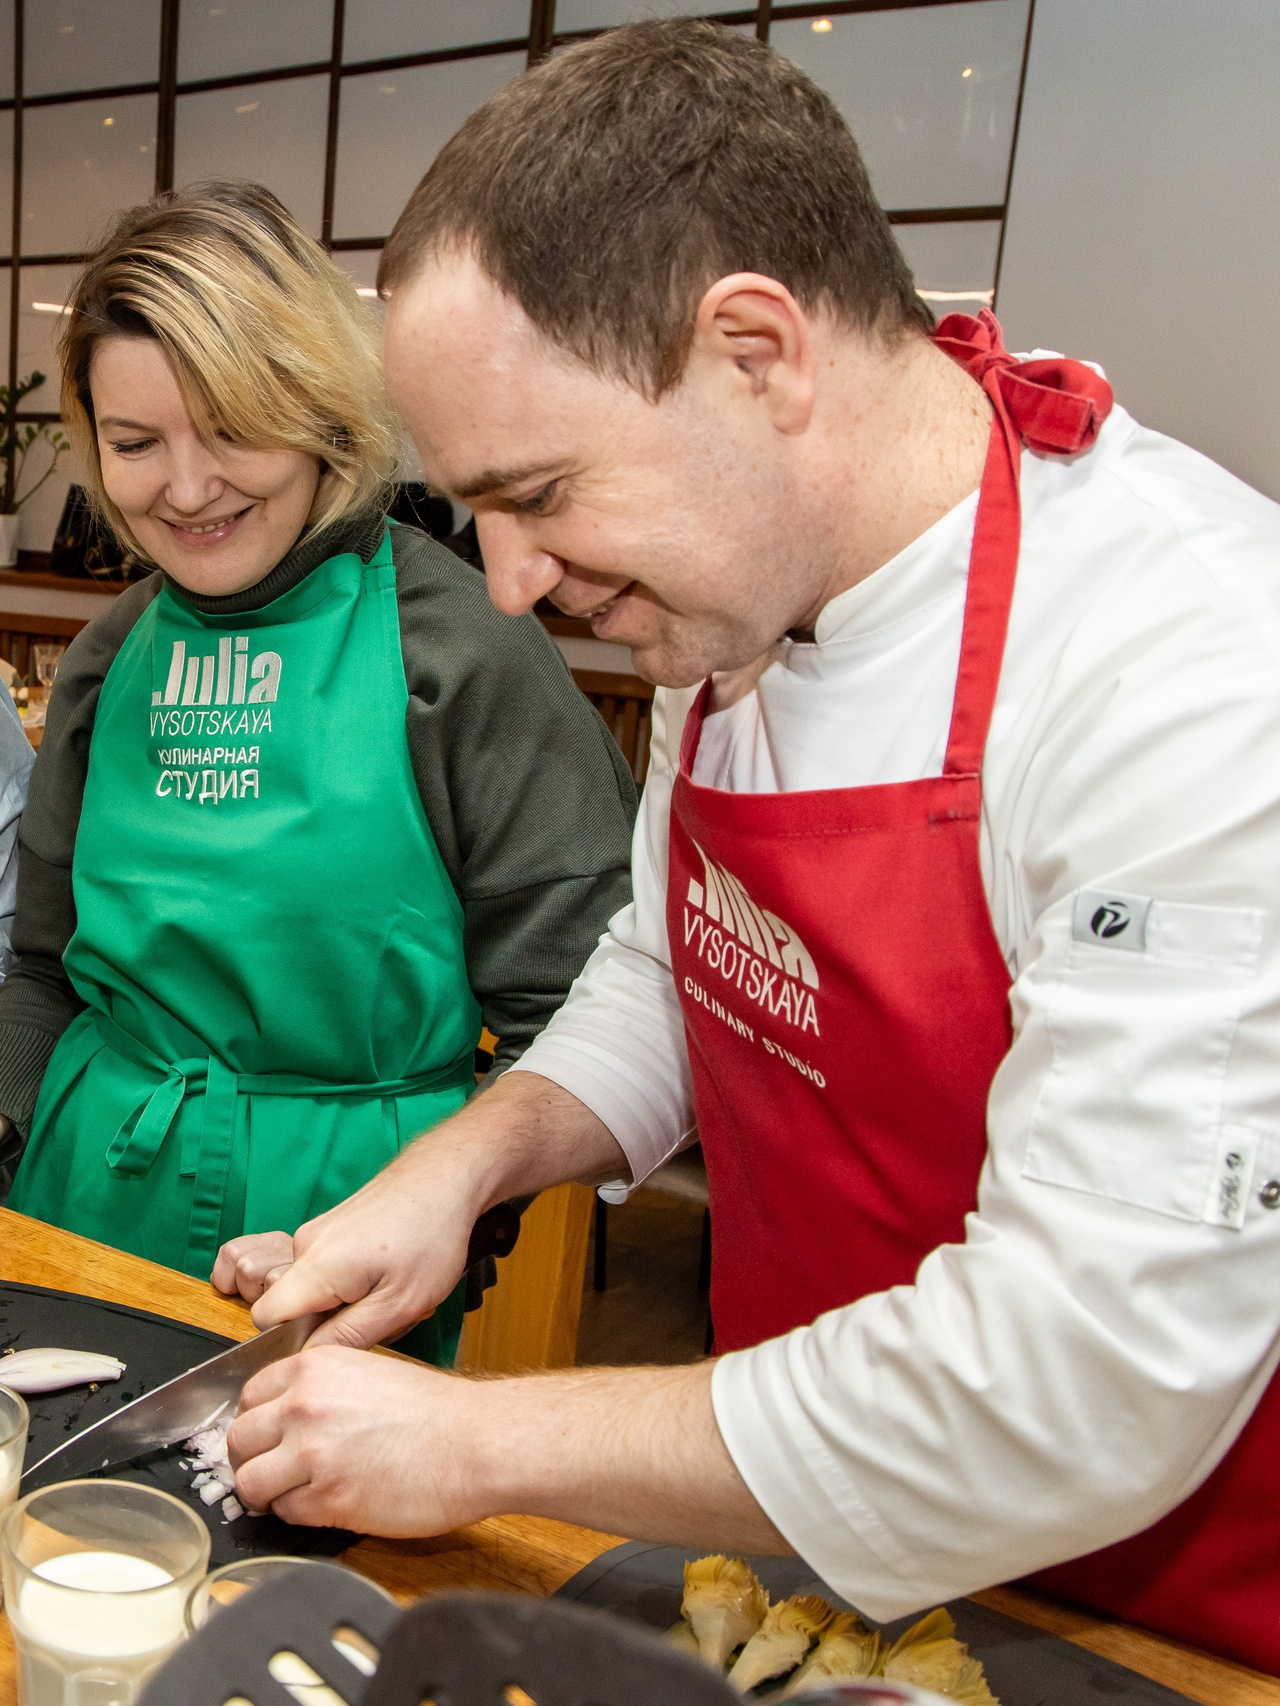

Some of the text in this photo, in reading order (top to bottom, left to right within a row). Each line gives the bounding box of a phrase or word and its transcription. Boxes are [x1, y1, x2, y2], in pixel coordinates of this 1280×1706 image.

[151, 636, 282, 706] Julia
[150, 708, 272, 737] VYSOTSKAYA
[158, 746, 260, 765] КУЛИНАРНАЯ
[155, 769, 259, 805] СТУДИЯ
[687, 837, 819, 990] Julia
[684, 906, 820, 1037] VYSOTSKAYA
[684, 976, 754, 1042] CULINARY
